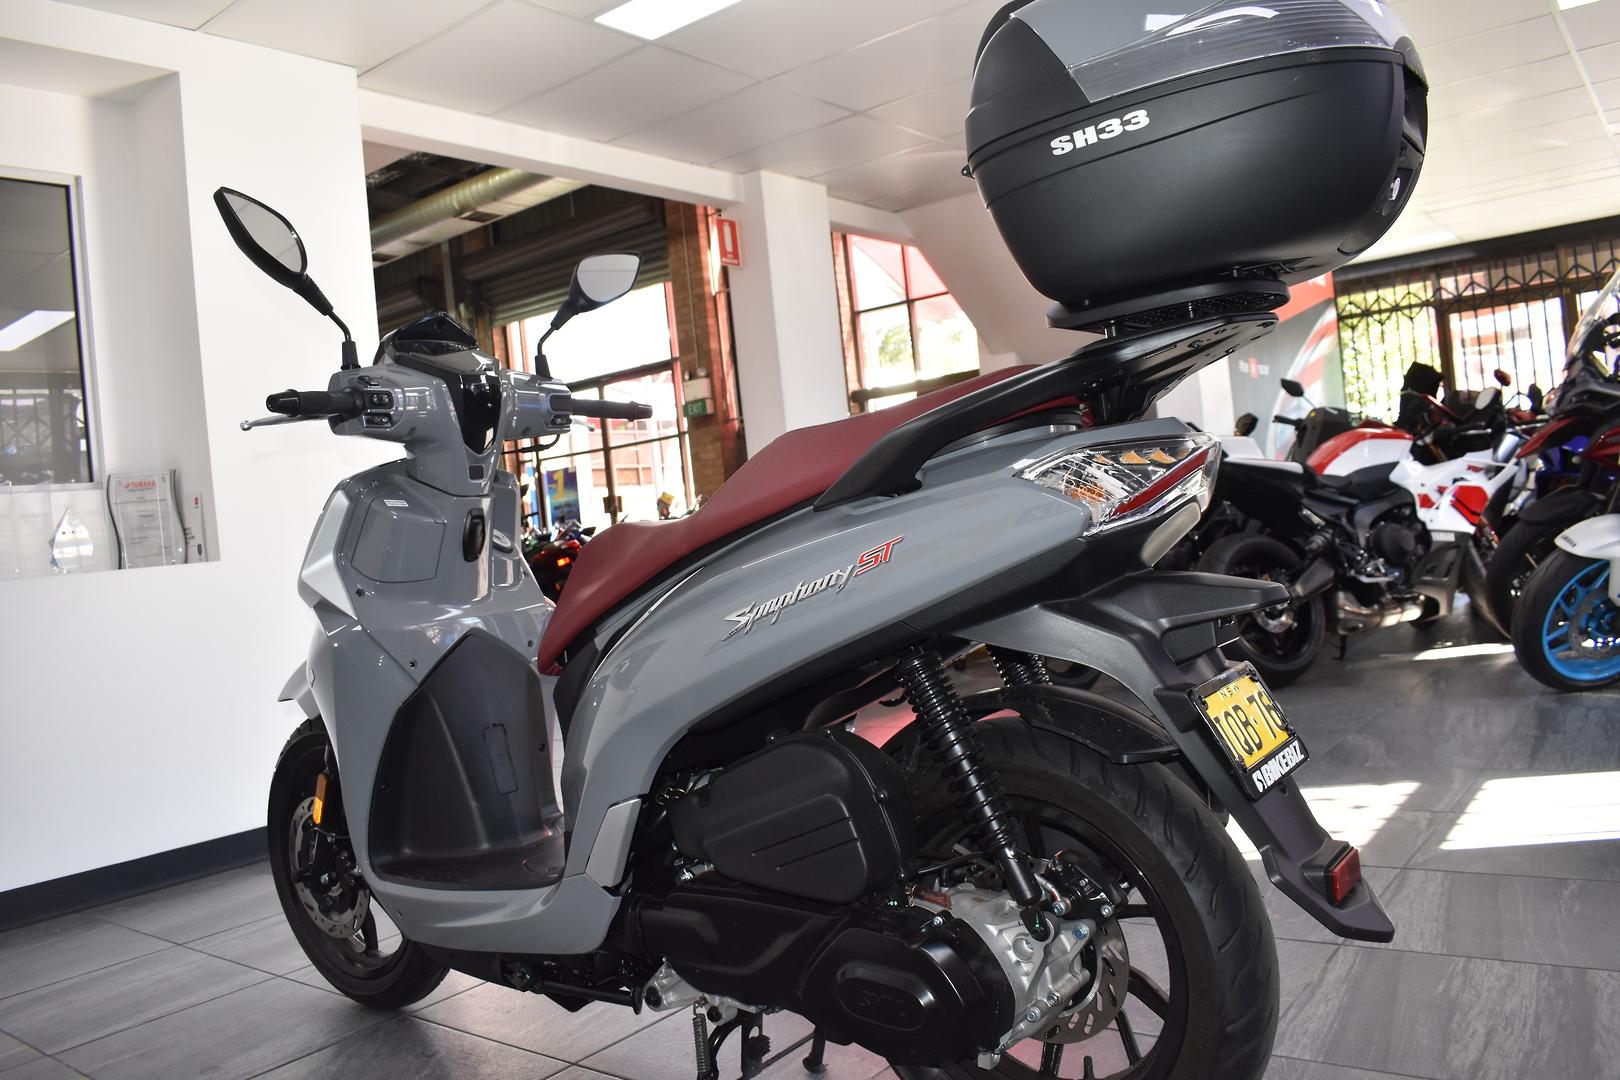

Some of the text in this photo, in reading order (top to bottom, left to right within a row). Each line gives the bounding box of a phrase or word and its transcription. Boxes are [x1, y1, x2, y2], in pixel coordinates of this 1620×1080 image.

[1050, 109, 1150, 156] SH33
[688, 402, 702, 416] EXIT
[721, 535, 905, 641] Symphony ST
